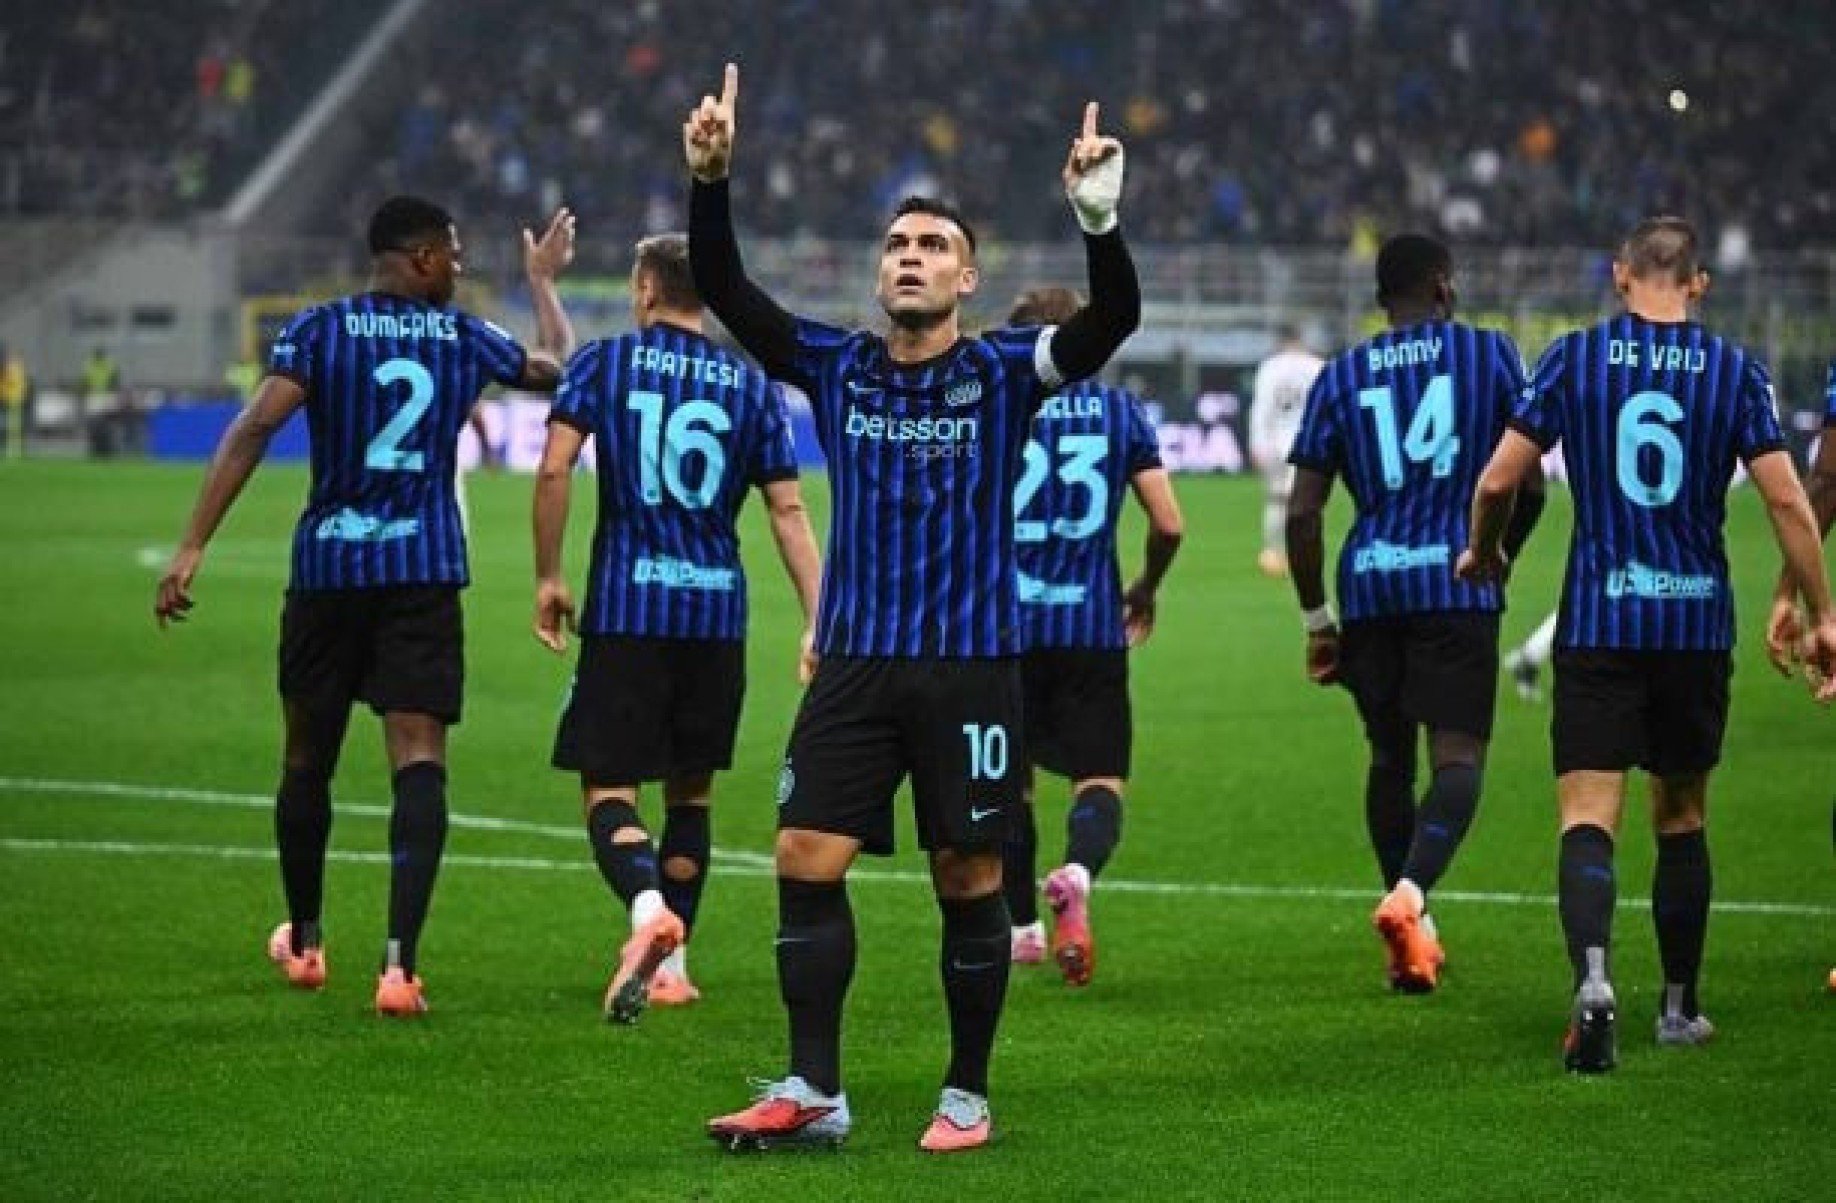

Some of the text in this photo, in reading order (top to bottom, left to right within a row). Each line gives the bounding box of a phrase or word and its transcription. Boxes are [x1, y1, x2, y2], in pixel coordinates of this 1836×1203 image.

[345, 312, 458, 341] DUMFRIES
[1368, 337, 1443, 371] BONNY
[631, 345, 740, 389] FRATTESI
[1609, 339, 1707, 373] DE VRIJ
[366, 358, 435, 471] 2
[845, 404, 978, 440] betsson
[1359, 374, 1461, 490] 14
[626, 391, 733, 509] 16
[1616, 391, 1685, 507] 6
[1013, 435, 1110, 541] 23
[963, 723, 1008, 780] 10
